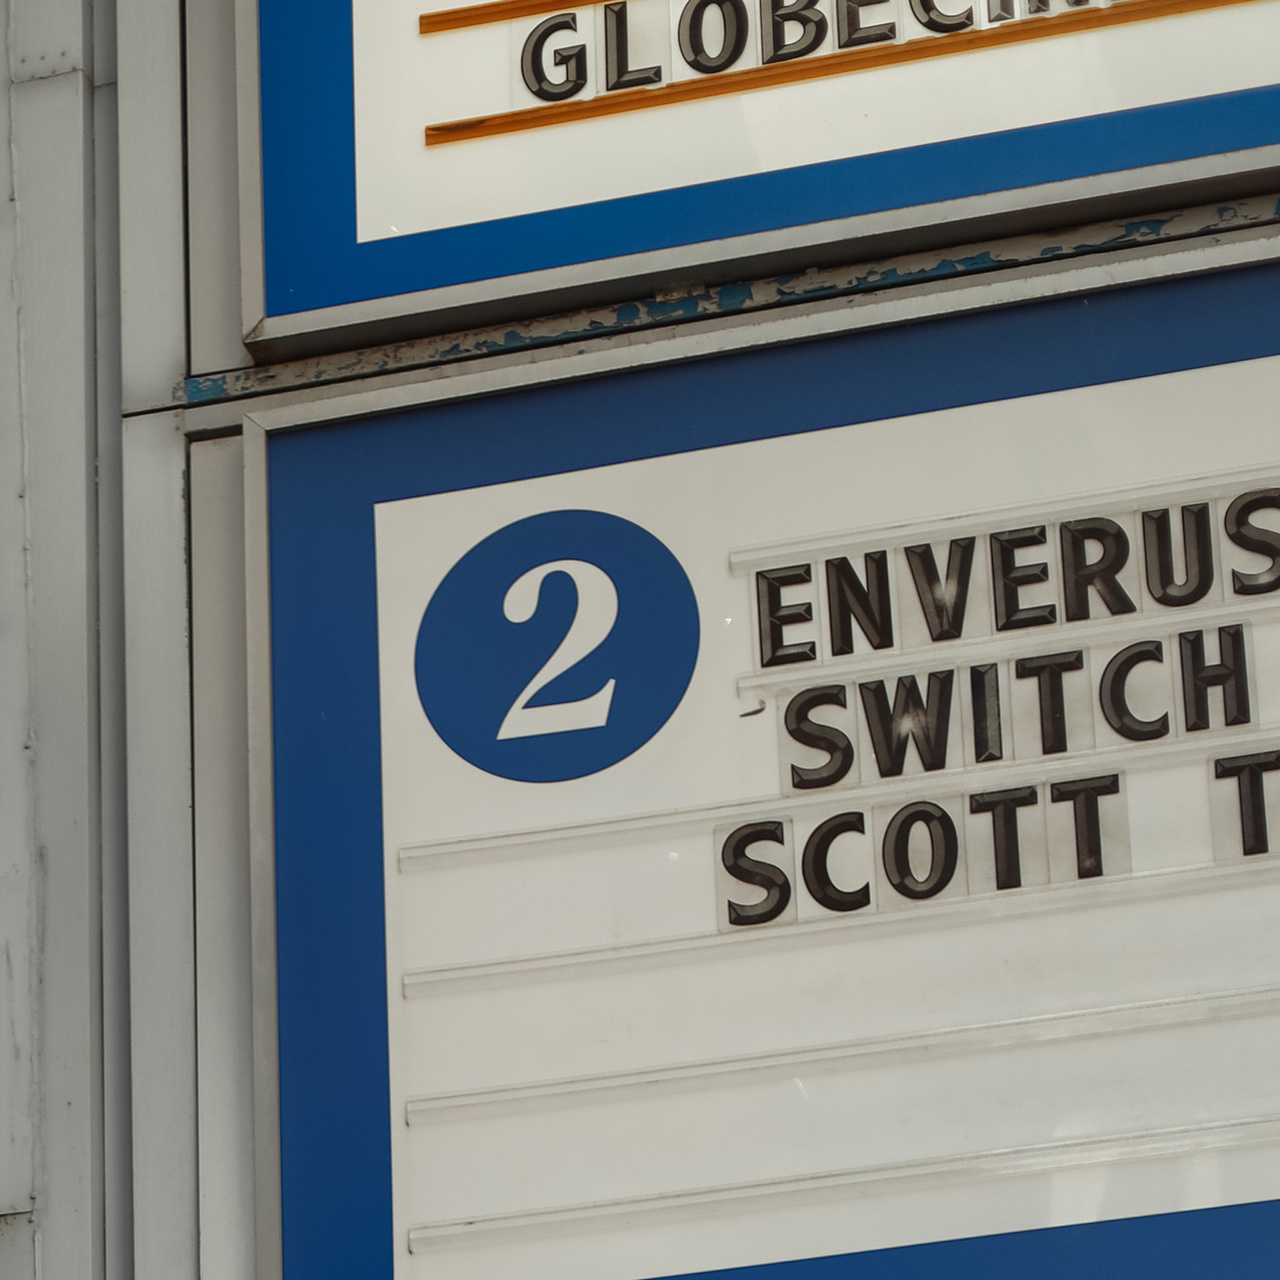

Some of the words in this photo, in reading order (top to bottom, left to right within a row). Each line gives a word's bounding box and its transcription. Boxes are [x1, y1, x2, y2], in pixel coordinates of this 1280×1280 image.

[496, 559, 619, 741] 2
[756, 487, 1280, 668] ENVERUS
[783, 624, 1251, 790] SWITCH
[721, 774, 1120, 926] SCOTT
